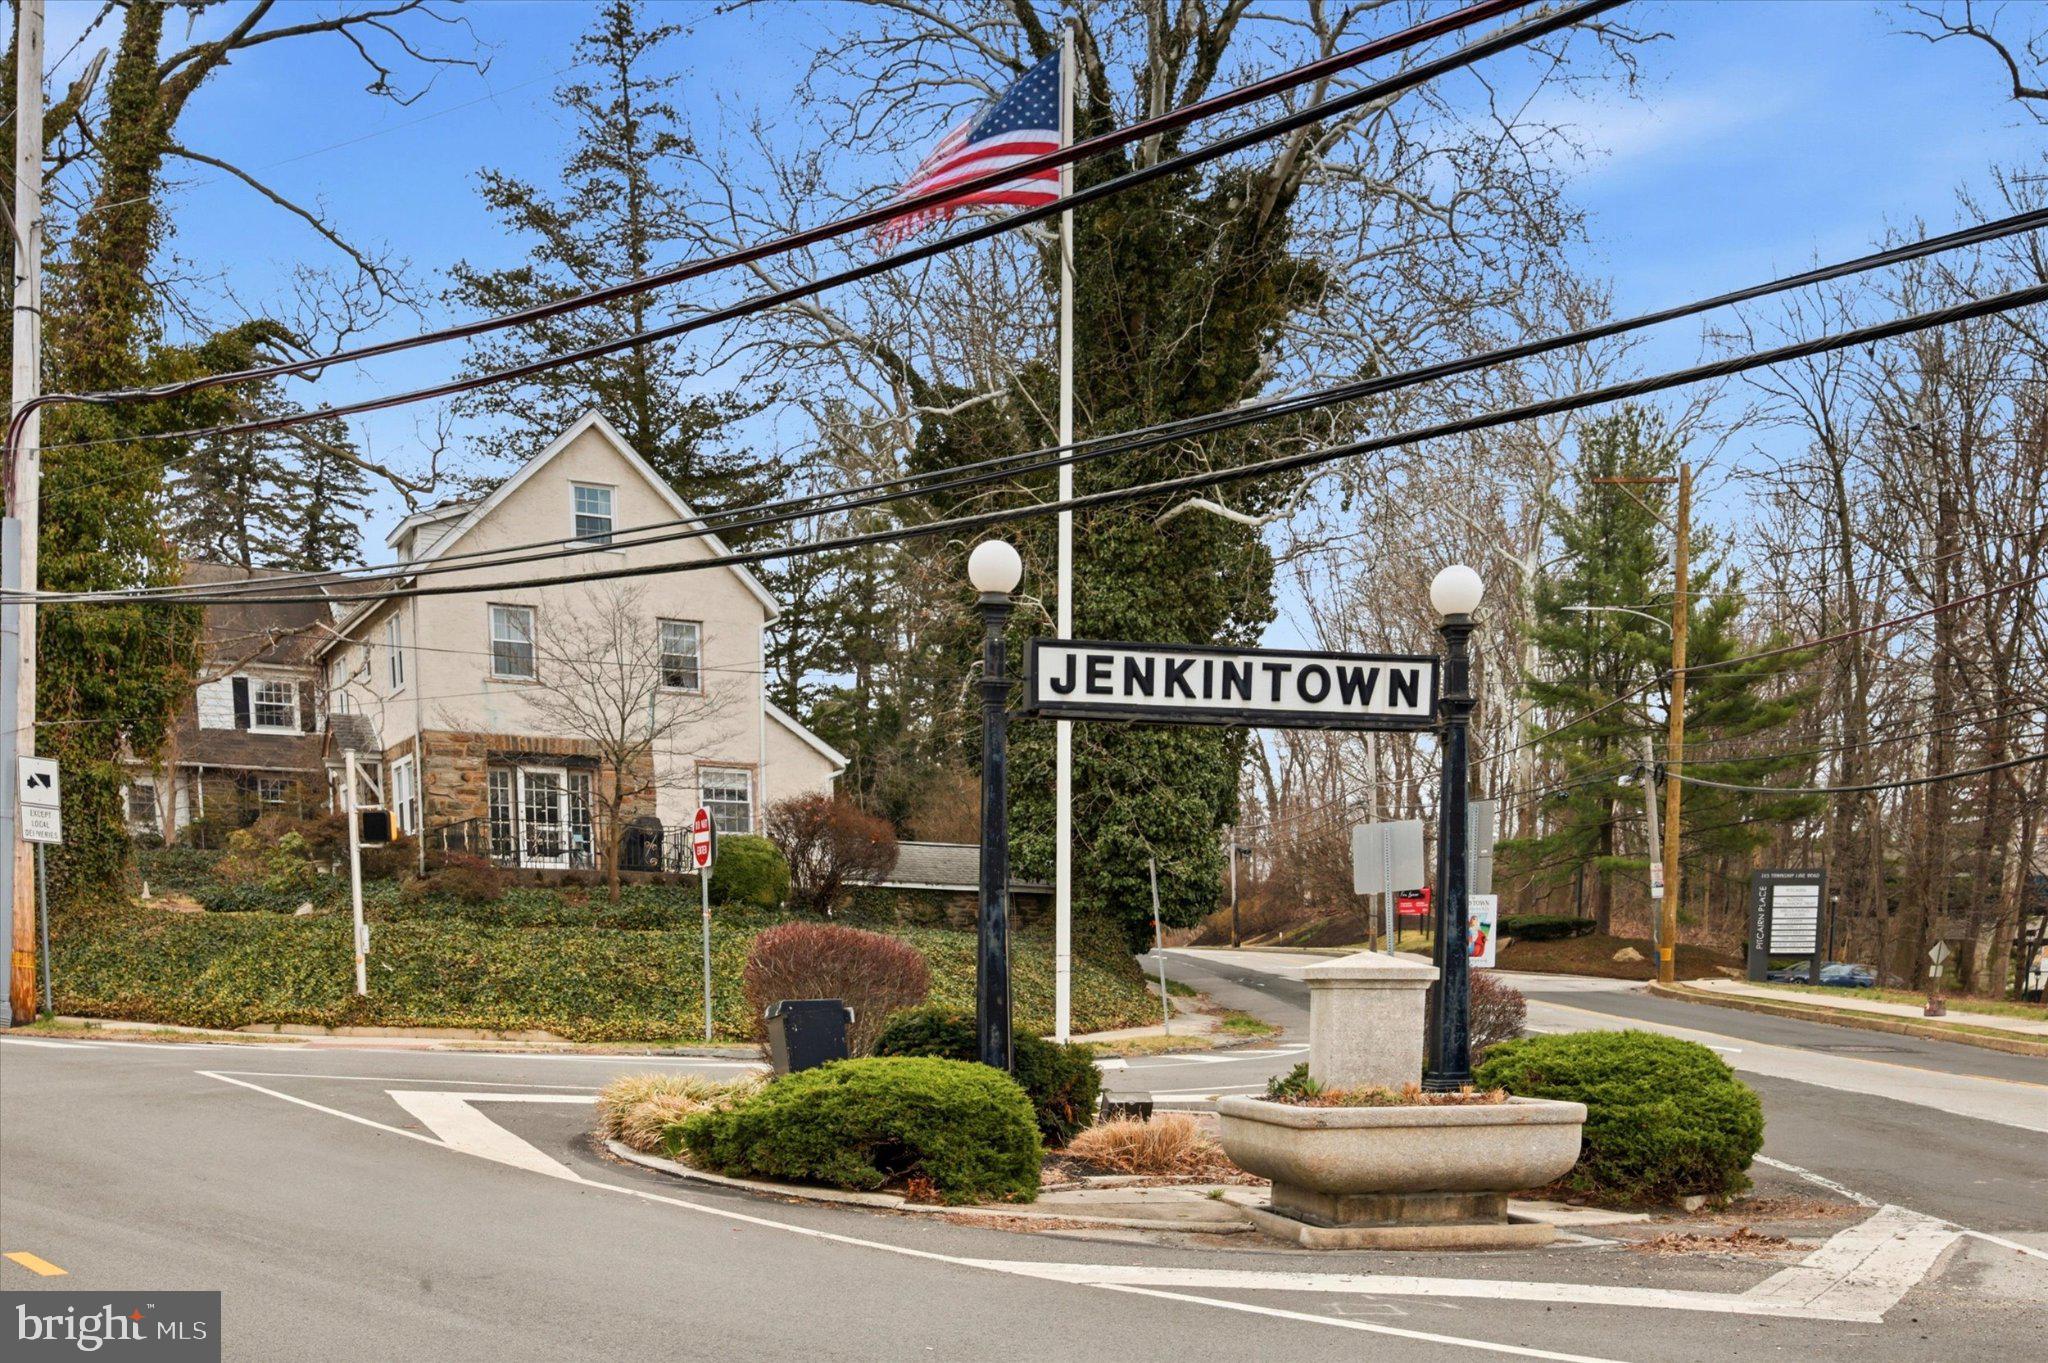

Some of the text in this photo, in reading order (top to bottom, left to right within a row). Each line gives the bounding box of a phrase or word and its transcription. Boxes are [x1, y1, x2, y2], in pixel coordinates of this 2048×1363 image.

[1050, 653, 1419, 708] JENKINTOWN
[30, 809, 51, 818] EXCEPT
[31, 820, 50, 829] LOCAL
[25, 829, 58, 839] DELIVERIES
[1755, 886, 1768, 950] PITCAIRN PLACE
